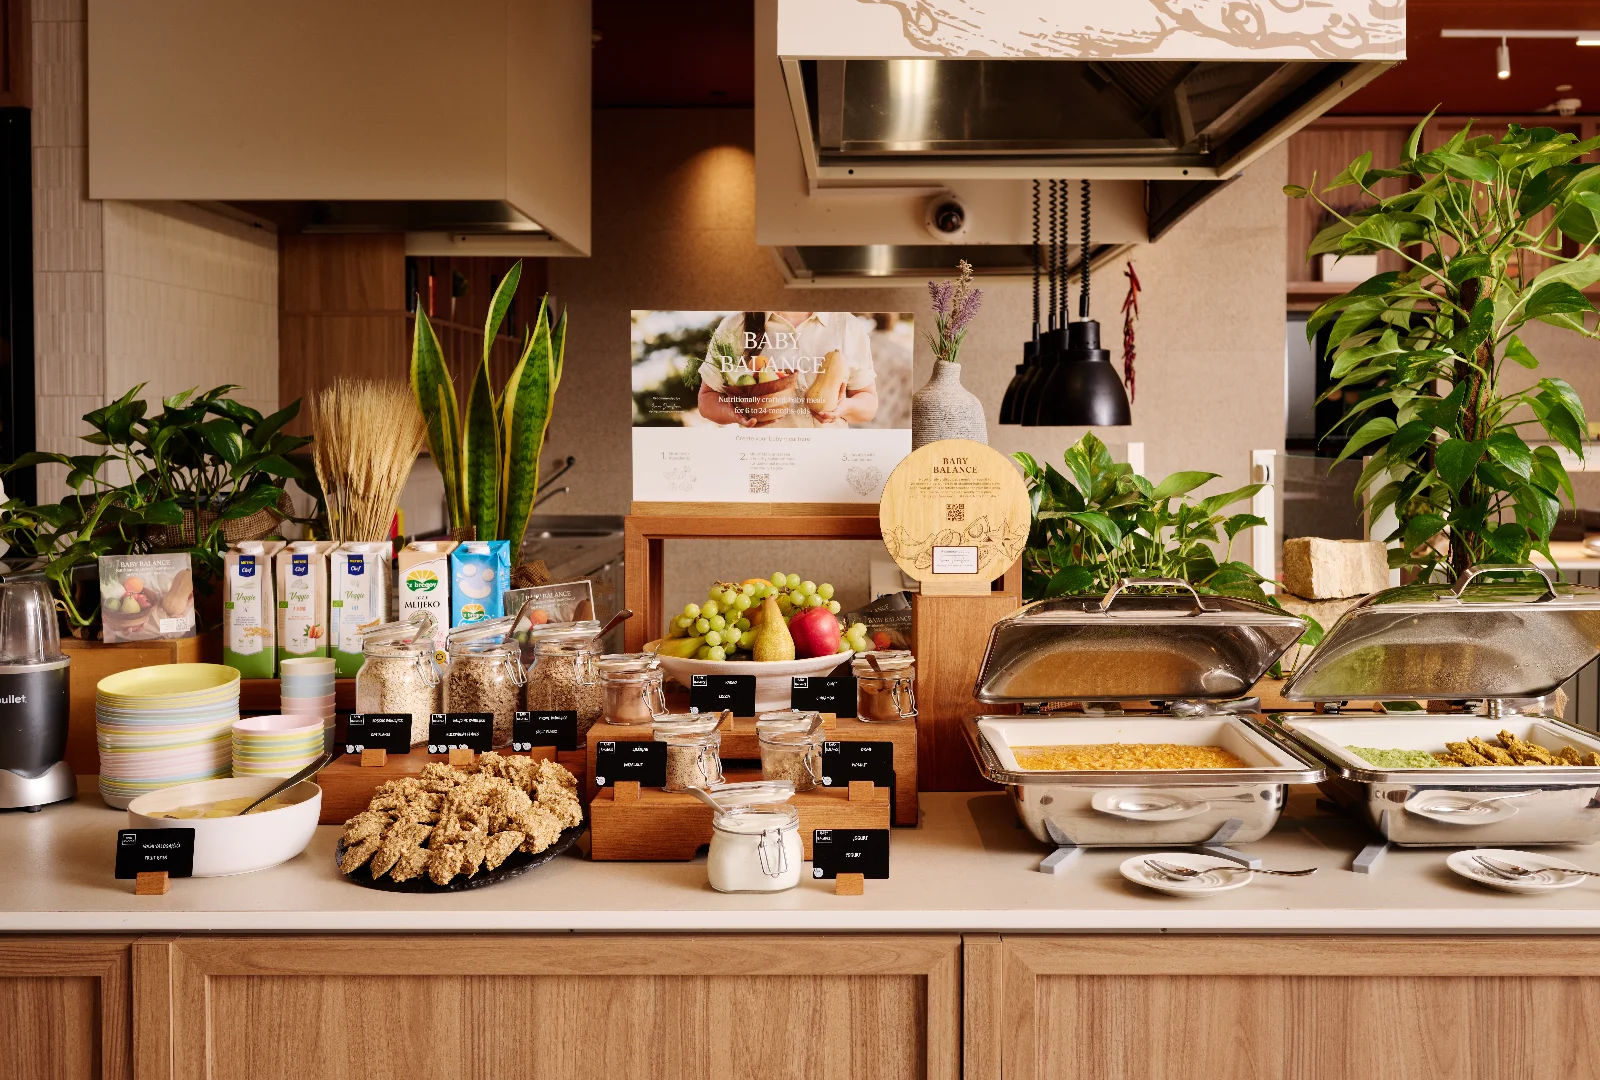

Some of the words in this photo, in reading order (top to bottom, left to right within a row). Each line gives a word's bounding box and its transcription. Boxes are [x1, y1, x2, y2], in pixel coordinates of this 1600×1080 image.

[743, 331, 802, 350] BABY
[719, 355, 826, 374] BALANCE
[718, 396, 761, 406] Nutritionally
[761, 396, 786, 404] crafted
[788, 396, 805, 406] baby
[942, 457, 969, 465] BABY
[933, 466, 978, 474] BALANCE
[235, 592, 256, 603] Veggie
[289, 592, 310, 602] Veggie
[345, 591, 365, 601] Veggie
[542, 590, 572, 599] BALANCE
[404, 600, 441, 609] MLIJEKO
[0, 694, 27, 704] ullet
